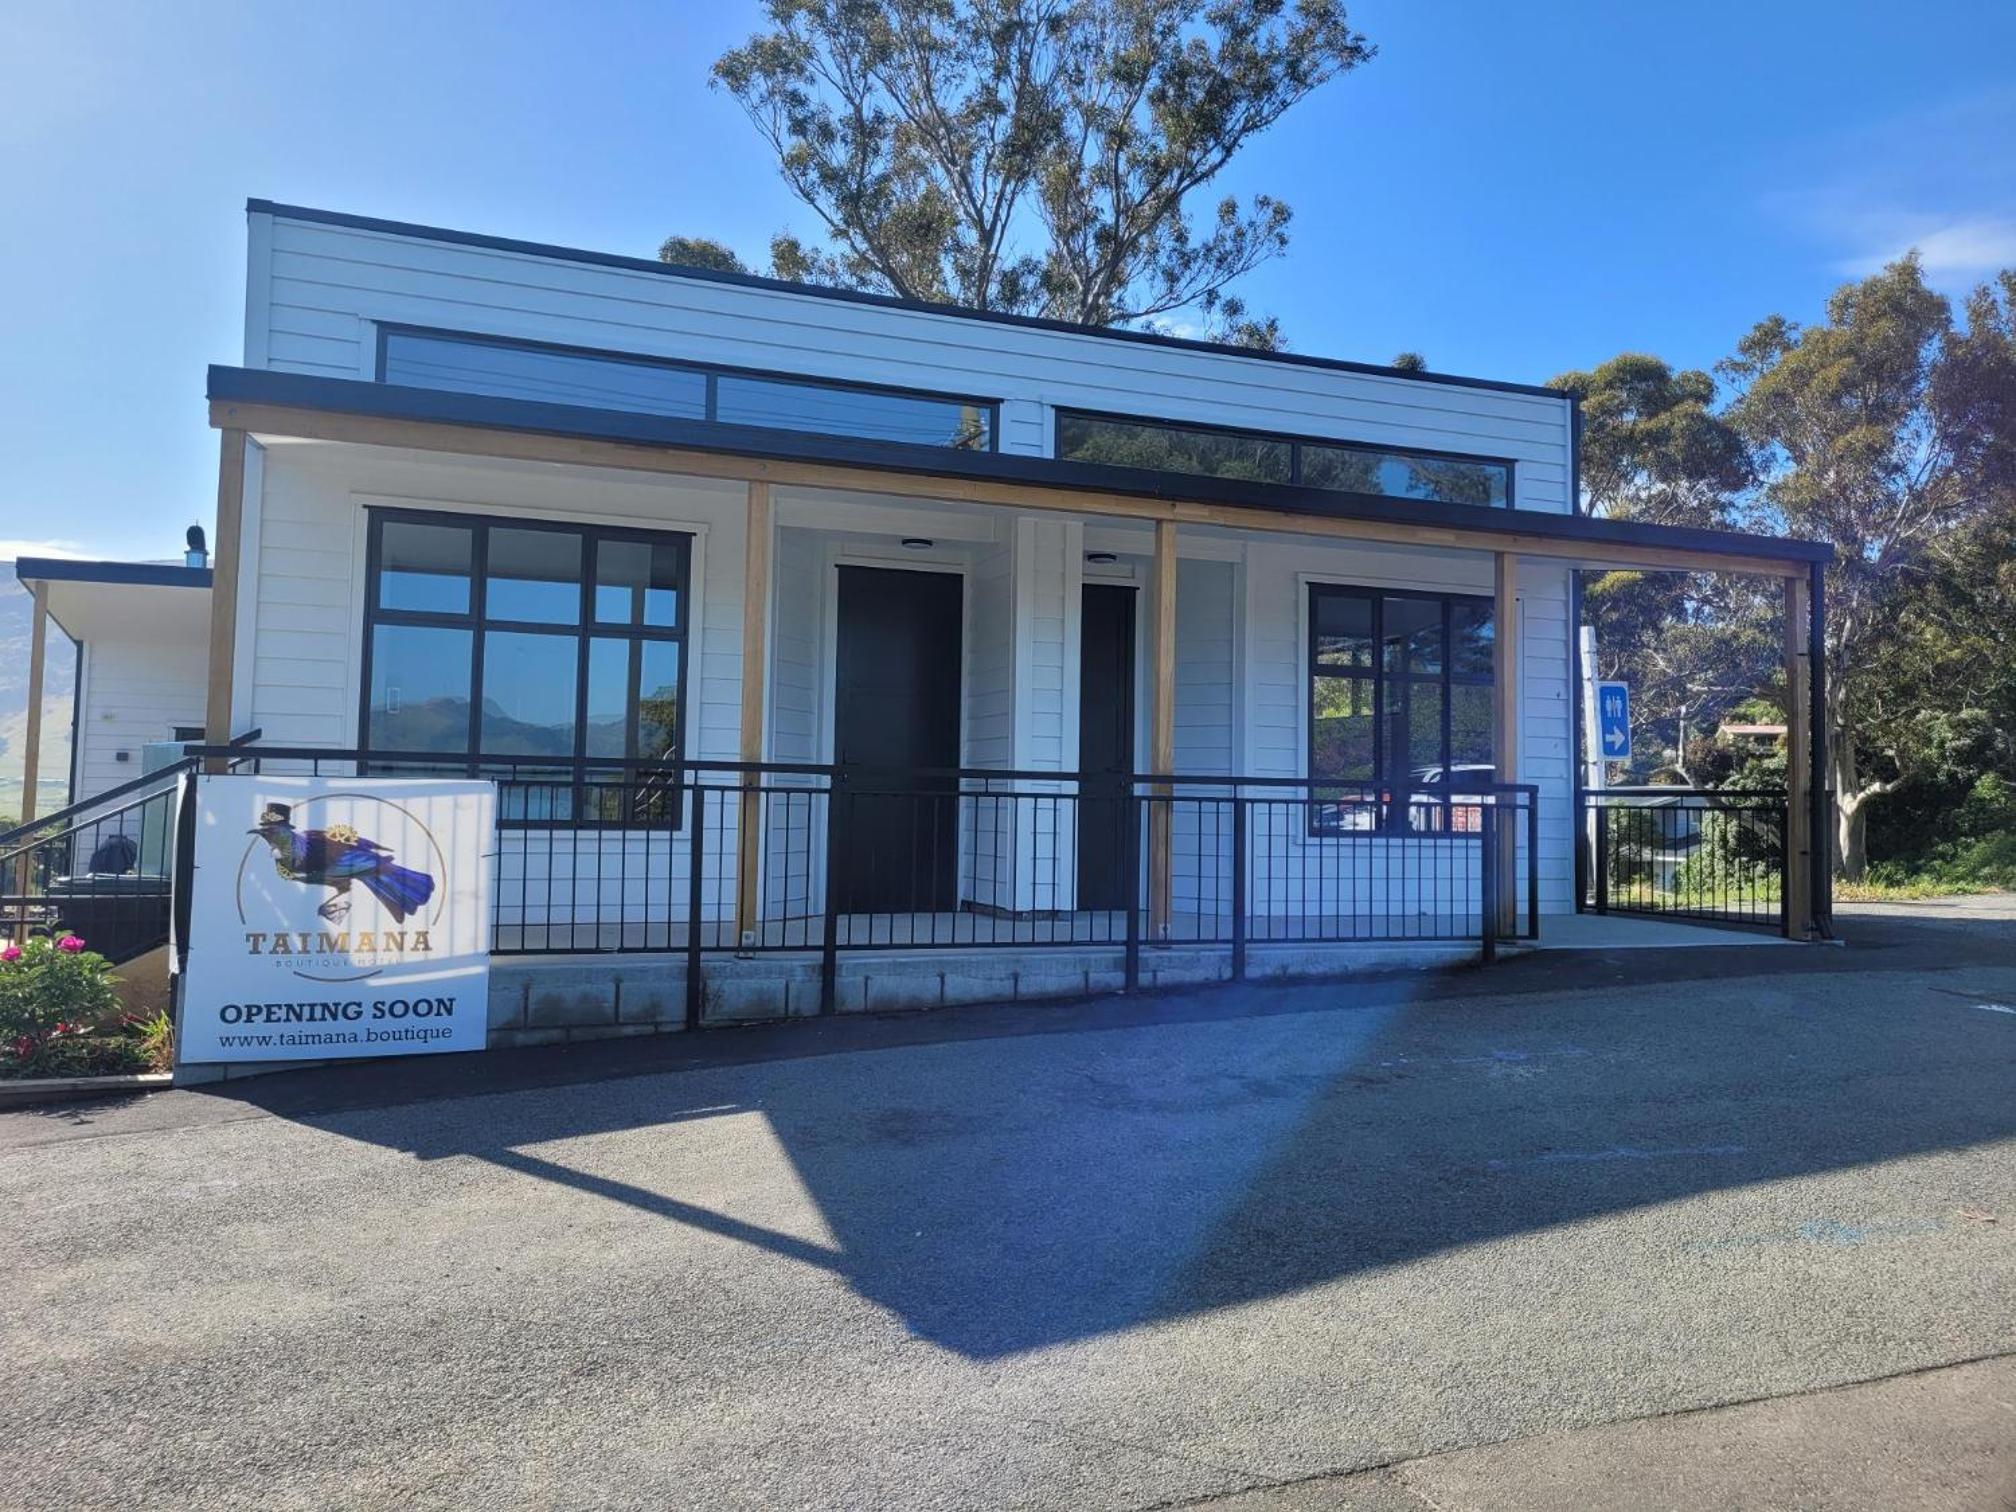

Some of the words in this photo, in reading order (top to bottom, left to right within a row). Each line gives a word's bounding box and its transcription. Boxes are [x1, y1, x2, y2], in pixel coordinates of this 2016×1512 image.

[246, 931, 432, 954] TAIMANA
[276, 959, 349, 968] BOUTIQUE
[219, 1002, 363, 1024] OPENING
[372, 998, 456, 1019] SOON
[219, 1026, 453, 1047] www.taimana.boutique
